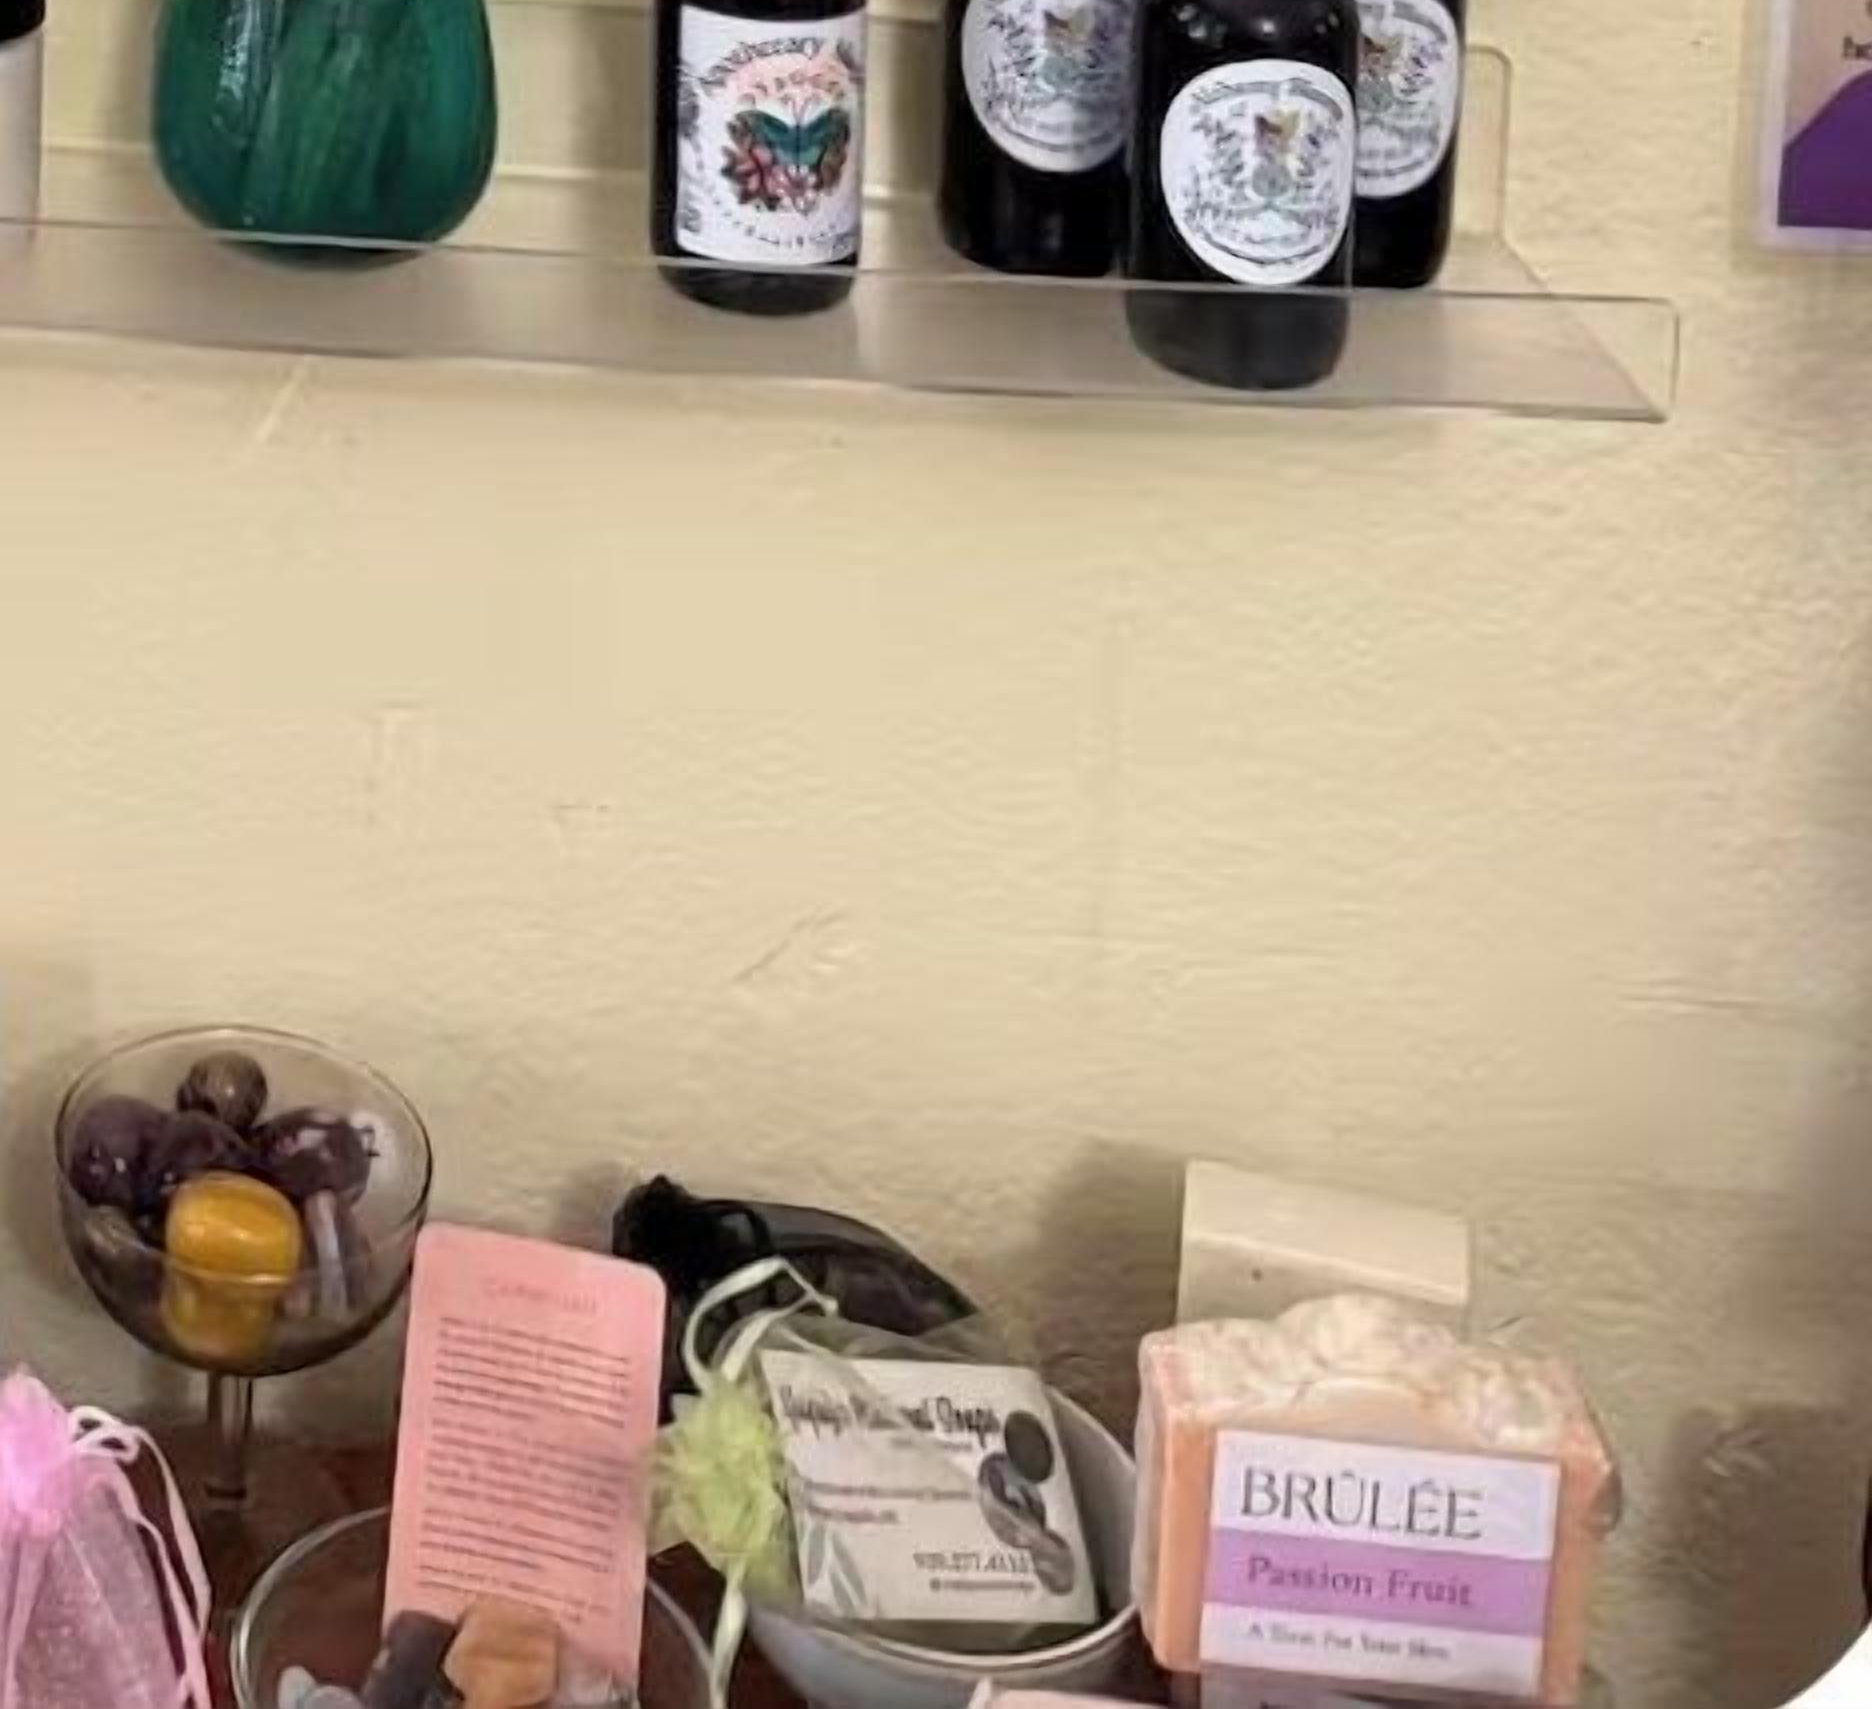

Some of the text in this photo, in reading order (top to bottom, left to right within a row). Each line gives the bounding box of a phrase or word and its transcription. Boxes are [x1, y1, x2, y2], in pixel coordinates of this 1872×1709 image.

[1240, 1465, 1487, 1542] BRÛLÉE
[1247, 1553, 1475, 1609] Passion Fruit
